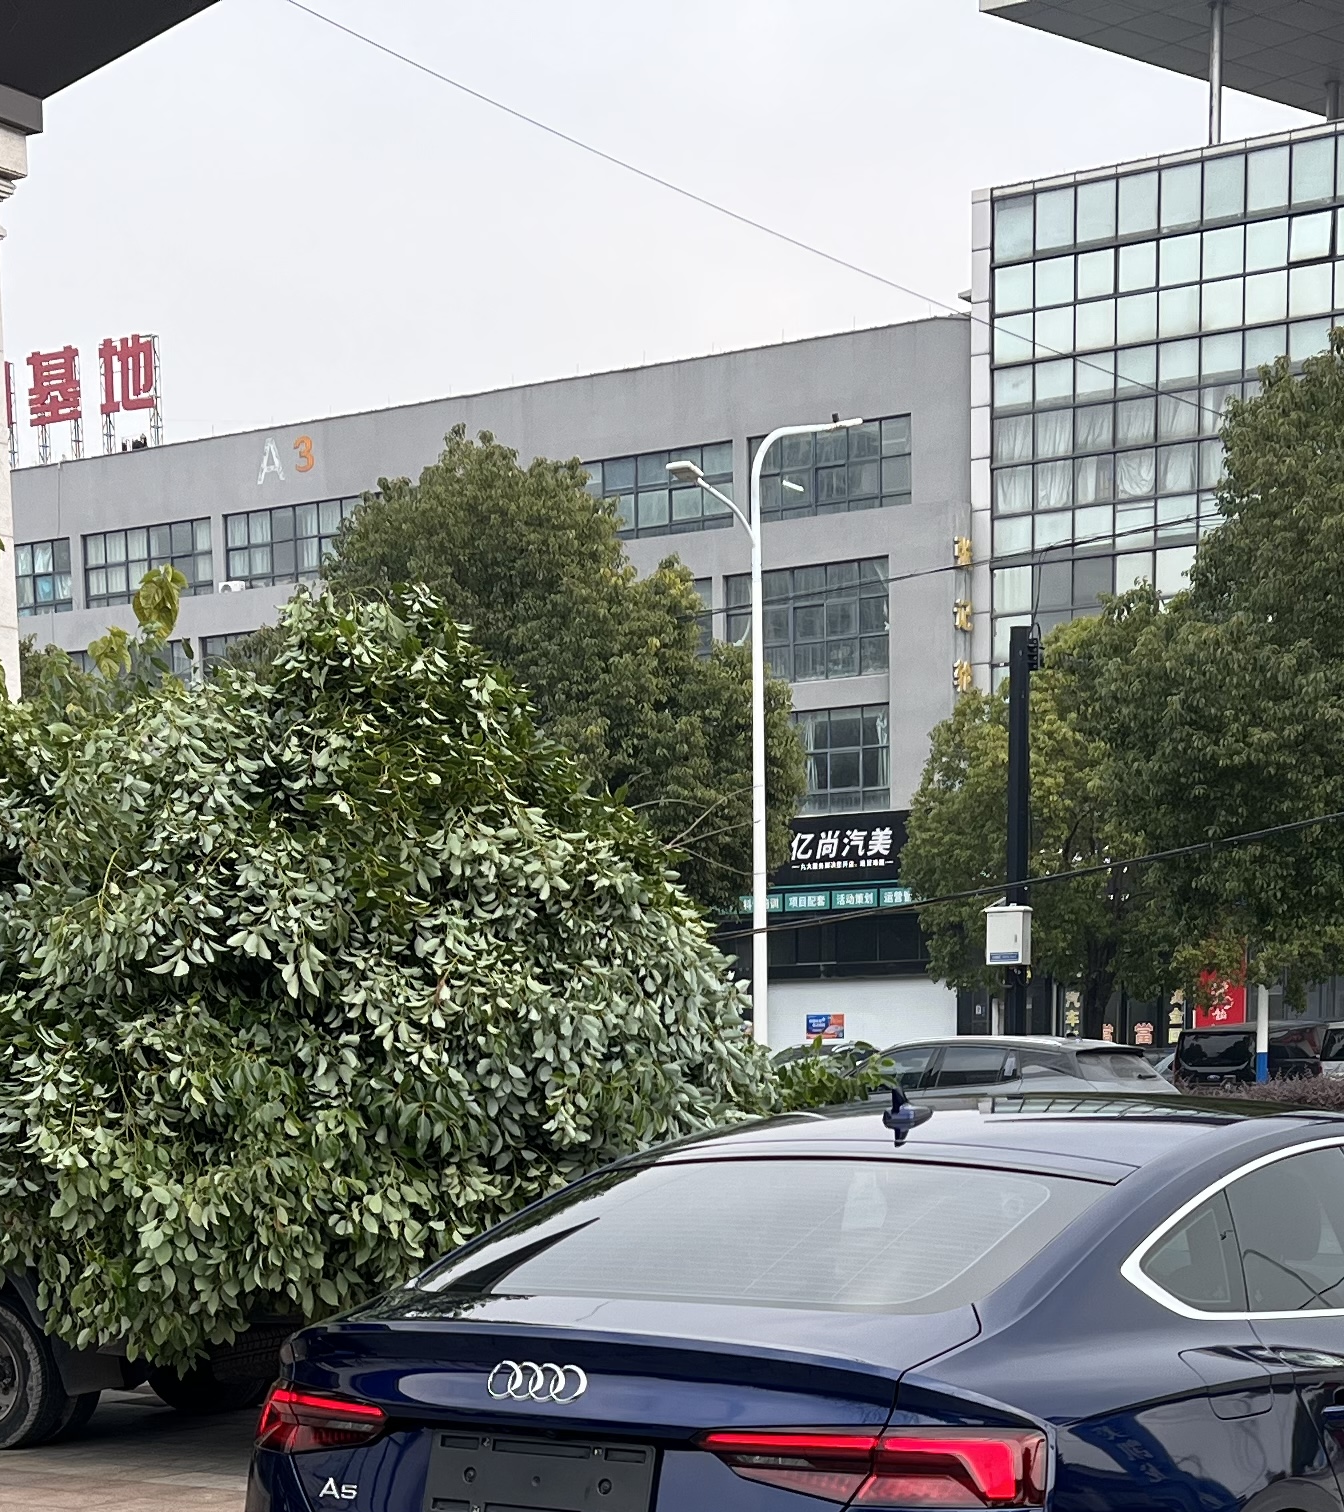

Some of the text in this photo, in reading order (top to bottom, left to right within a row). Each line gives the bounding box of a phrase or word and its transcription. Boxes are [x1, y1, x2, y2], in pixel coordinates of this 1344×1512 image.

[4, 333, 155, 428] 基地
[257, 435, 315, 485] A3
[791, 827, 893, 860] 亿尚汽美
[319, 1477, 357, 1499] A5
